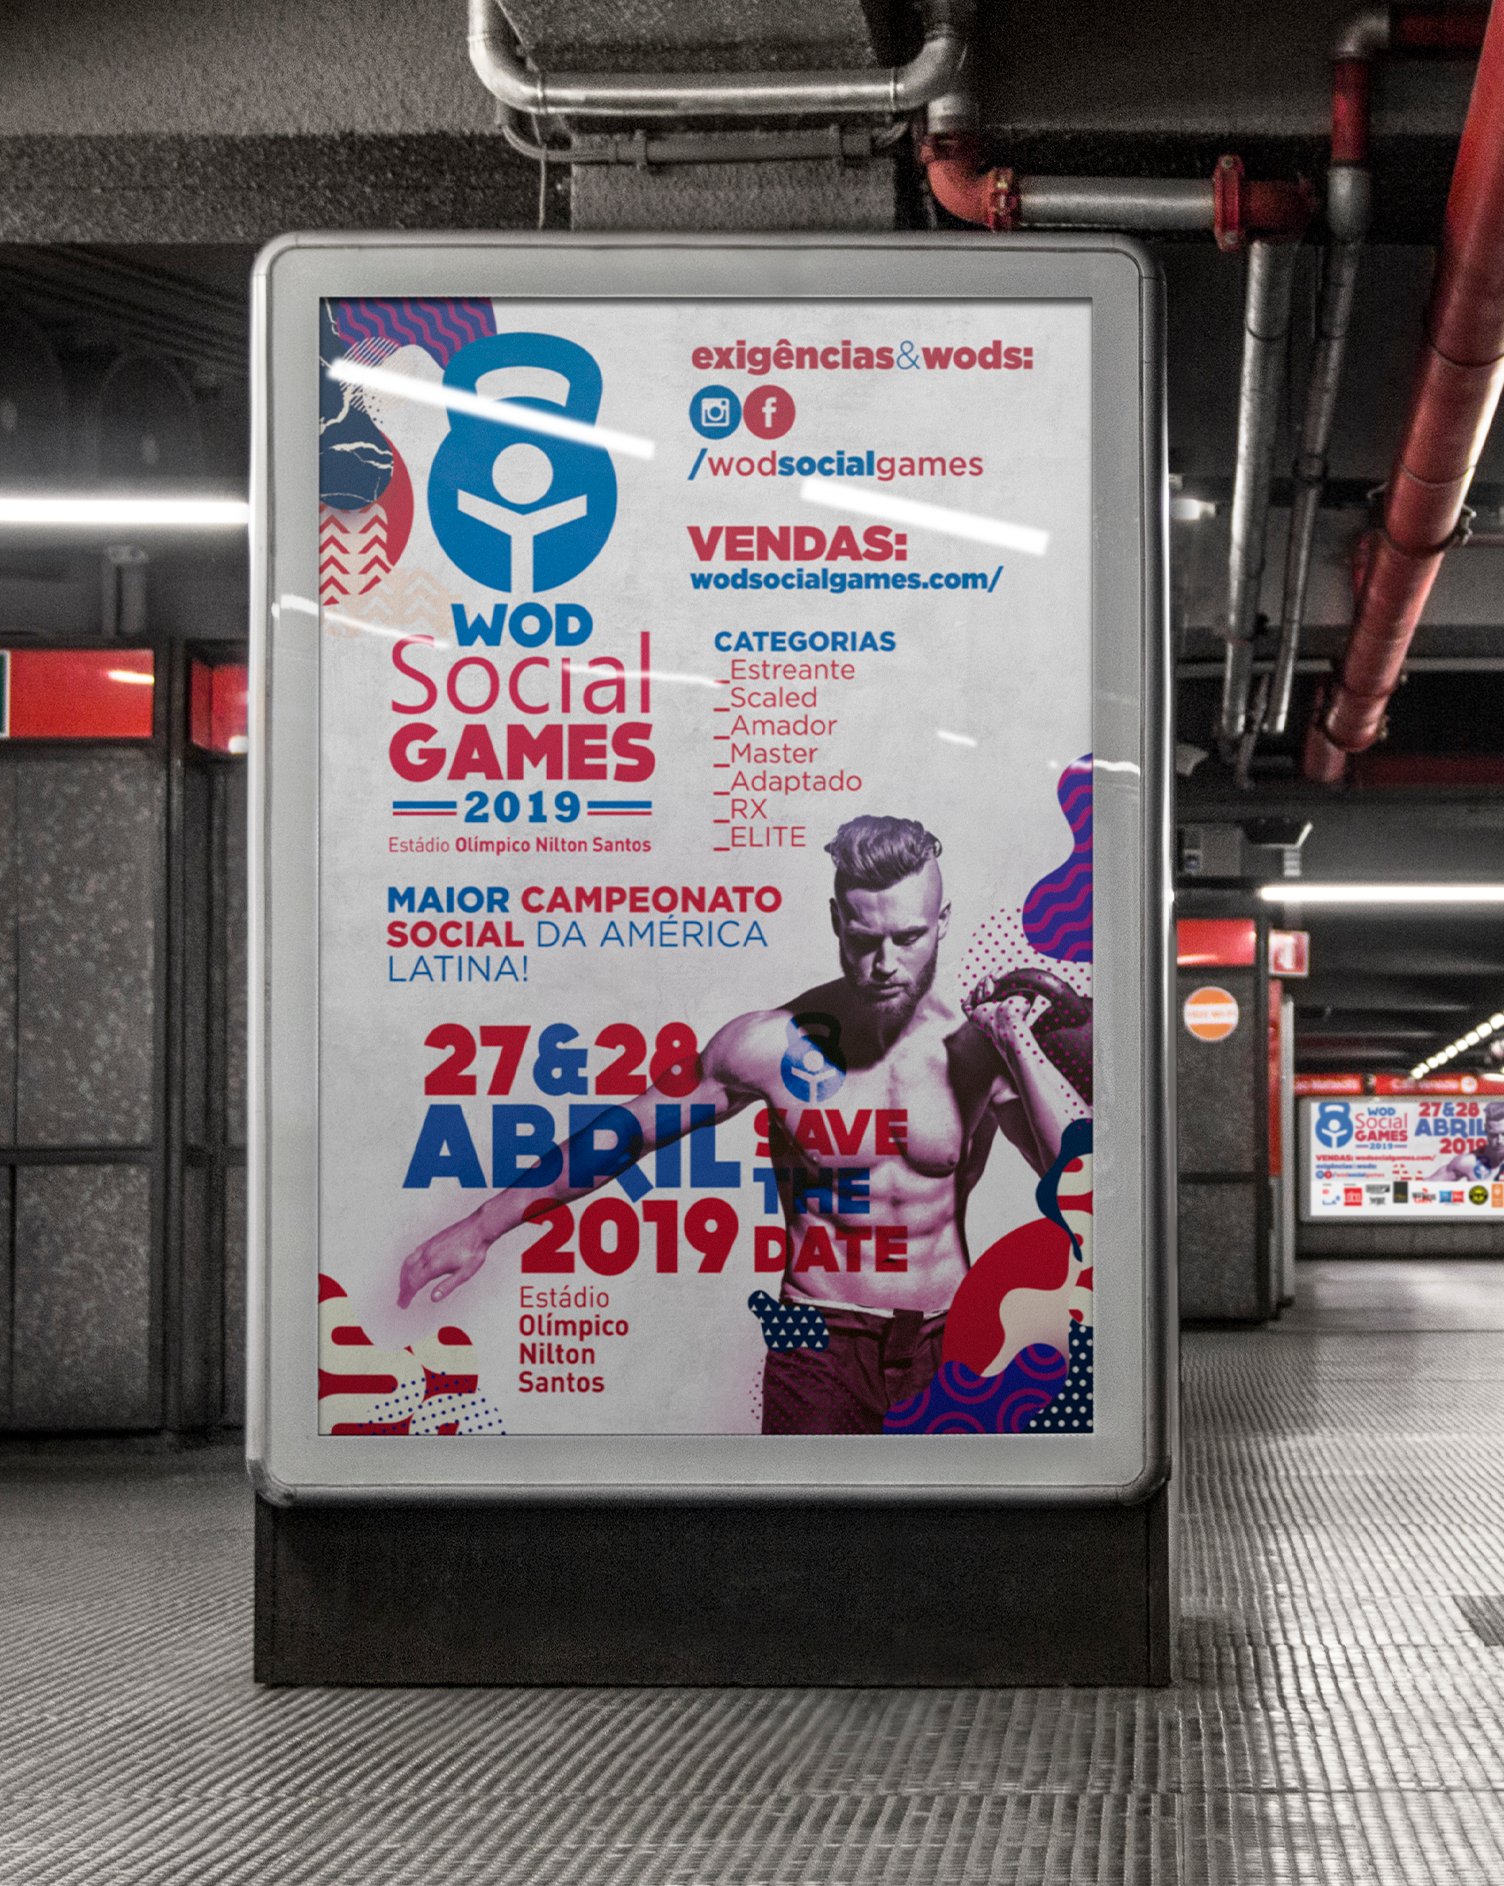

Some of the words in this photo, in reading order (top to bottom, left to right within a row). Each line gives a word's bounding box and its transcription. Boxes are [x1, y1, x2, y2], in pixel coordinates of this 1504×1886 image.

[687, 447, 984, 481] /wodsocialgames
[686, 525, 908, 561] VENDAS:
[690, 565, 1004, 593] wodsocialgames.com/
[450, 602, 594, 648] WOD
[714, 631, 897, 652] CATEGORIAS
[391, 631, 651, 715] Social
[388, 721, 656, 783] GAMES
[463, 790, 581, 823] 2019
[388, 836, 450, 853] Estádio
[455, 835, 530, 856] Olímpico
[536, 836, 588, 852] Nilton
[592, 836, 652, 852] Santos
[387, 886, 510, 913] MAIOR
[521, 886, 782, 914] CAMPEONATO
[386, 920, 525, 948] SOCIAL
[537, 920, 587, 947] DA
[599, 914, 769, 947] AMÉRICA
[388, 955, 528, 982] LATINA!
[423, 1022, 699, 1098] 27&28
[1354, 1112, 1408, 1129] Social
[1367, 1107, 1396, 1116] WOD
[753, 1107, 909, 1158] SAVE
[1354, 1130, 1408, 1142] GAMES
[1414, 1118, 1487, 1139] ABRIL
[402, 1103, 741, 1203] ABRIL
[1439, 1138, 1488, 1154] 2019
[753, 1167, 871, 1214] THE
[520, 1196, 739, 1276] 2019
[753, 1225, 909, 1273] DATE
[519, 1286, 610, 1308] Estádio
[518, 1314, 630, 1341] Olímpico
[518, 1342, 595, 1365] Nilton
[517, 1371, 606, 1393] Santos
